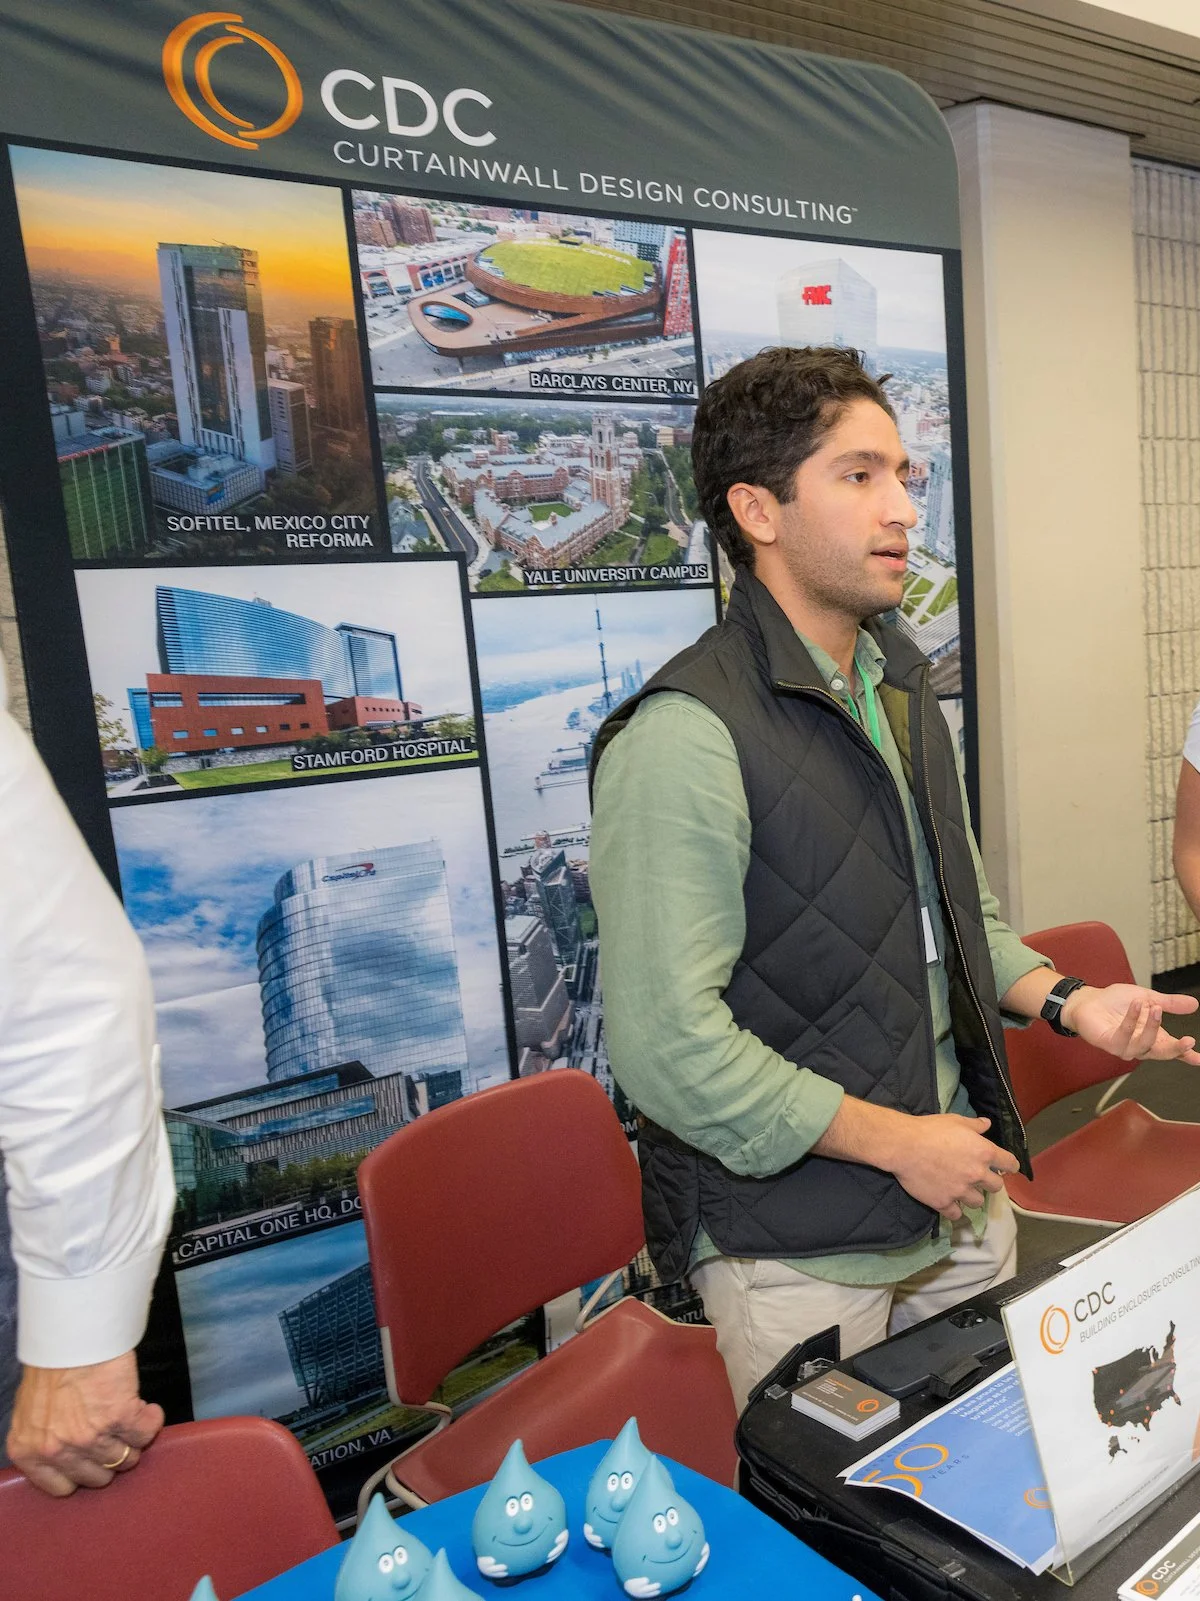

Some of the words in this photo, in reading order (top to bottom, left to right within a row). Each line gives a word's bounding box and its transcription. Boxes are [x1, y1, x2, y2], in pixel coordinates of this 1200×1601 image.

[320, 69, 497, 147] CDC
[333, 140, 569, 191] CURTAINWALL
[579, 172, 684, 205] DESIGN
[530, 372, 607, 390] BARCLAYS
[612, 375, 670, 394] CENTER,
[673, 379, 694, 395] NY
[167, 516, 251, 533] SOFITEL,
[255, 515, 318, 531] MEXICO
[321, 515, 370, 530] CITY
[286, 533, 373, 549] REFORMA
[525, 569, 561, 585] YALE
[564, 567, 648, 583] UNIVERSITY
[650, 565, 708, 580] CAMPUS
[294, 746, 389, 771] STAMFORD
[393, 739, 471, 760] HOSPITAL
[179, 1228, 257, 1259] CAPITAL
[260, 1213, 299, 1236] ONE
[305, 1205, 337, 1224] HQ,
[1074, 1282, 1116, 1322] CDC
[1080, 1311, 1117, 1343] BUILDING
[1118, 1281, 1161, 1318] ENCLOSURE
[308, 1439, 365, 1467] ATION,
[369, 1429, 392, 1445] VA
[1152, 1559, 1176, 1581] CDC
